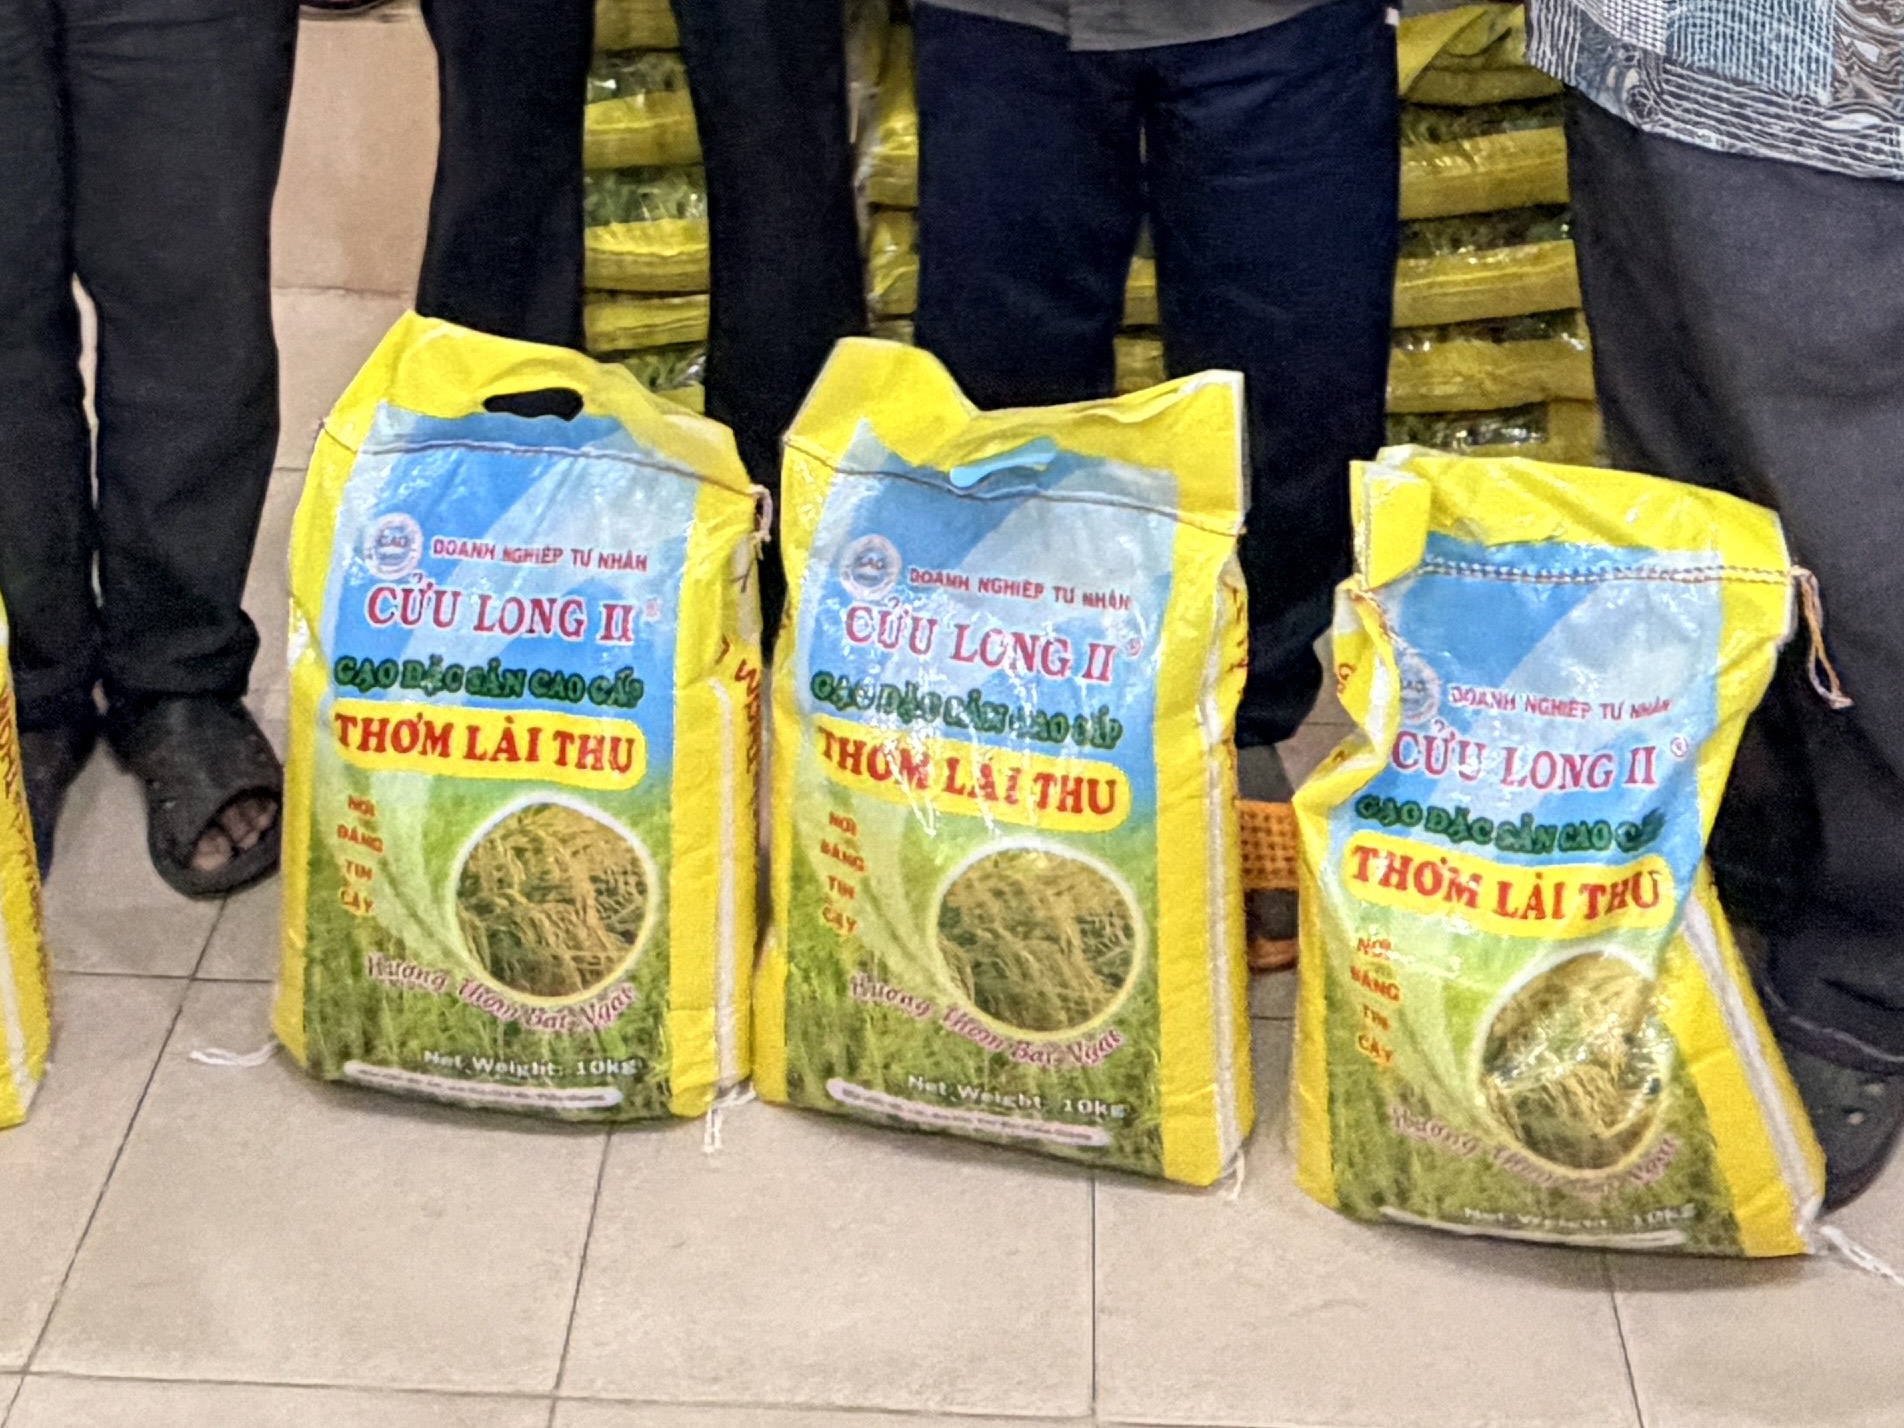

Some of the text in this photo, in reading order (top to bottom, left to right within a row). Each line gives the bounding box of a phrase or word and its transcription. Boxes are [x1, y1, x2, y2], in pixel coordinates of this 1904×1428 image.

[432, 538, 496, 561] DOANH
[367, 572, 634, 642] CỬU LONG II
[846, 595, 1116, 682] CỬU LONG II
[528, 668, 587, 701] CAO
[335, 711, 454, 758] THƠM
[553, 730, 636, 774] THU
[1500, 745, 1615, 790] LONG
[1624, 745, 1657, 785] II
[1033, 772, 1118, 815] THU
[1352, 844, 1483, 909] THƠM
[1580, 869, 1664, 921] THU
